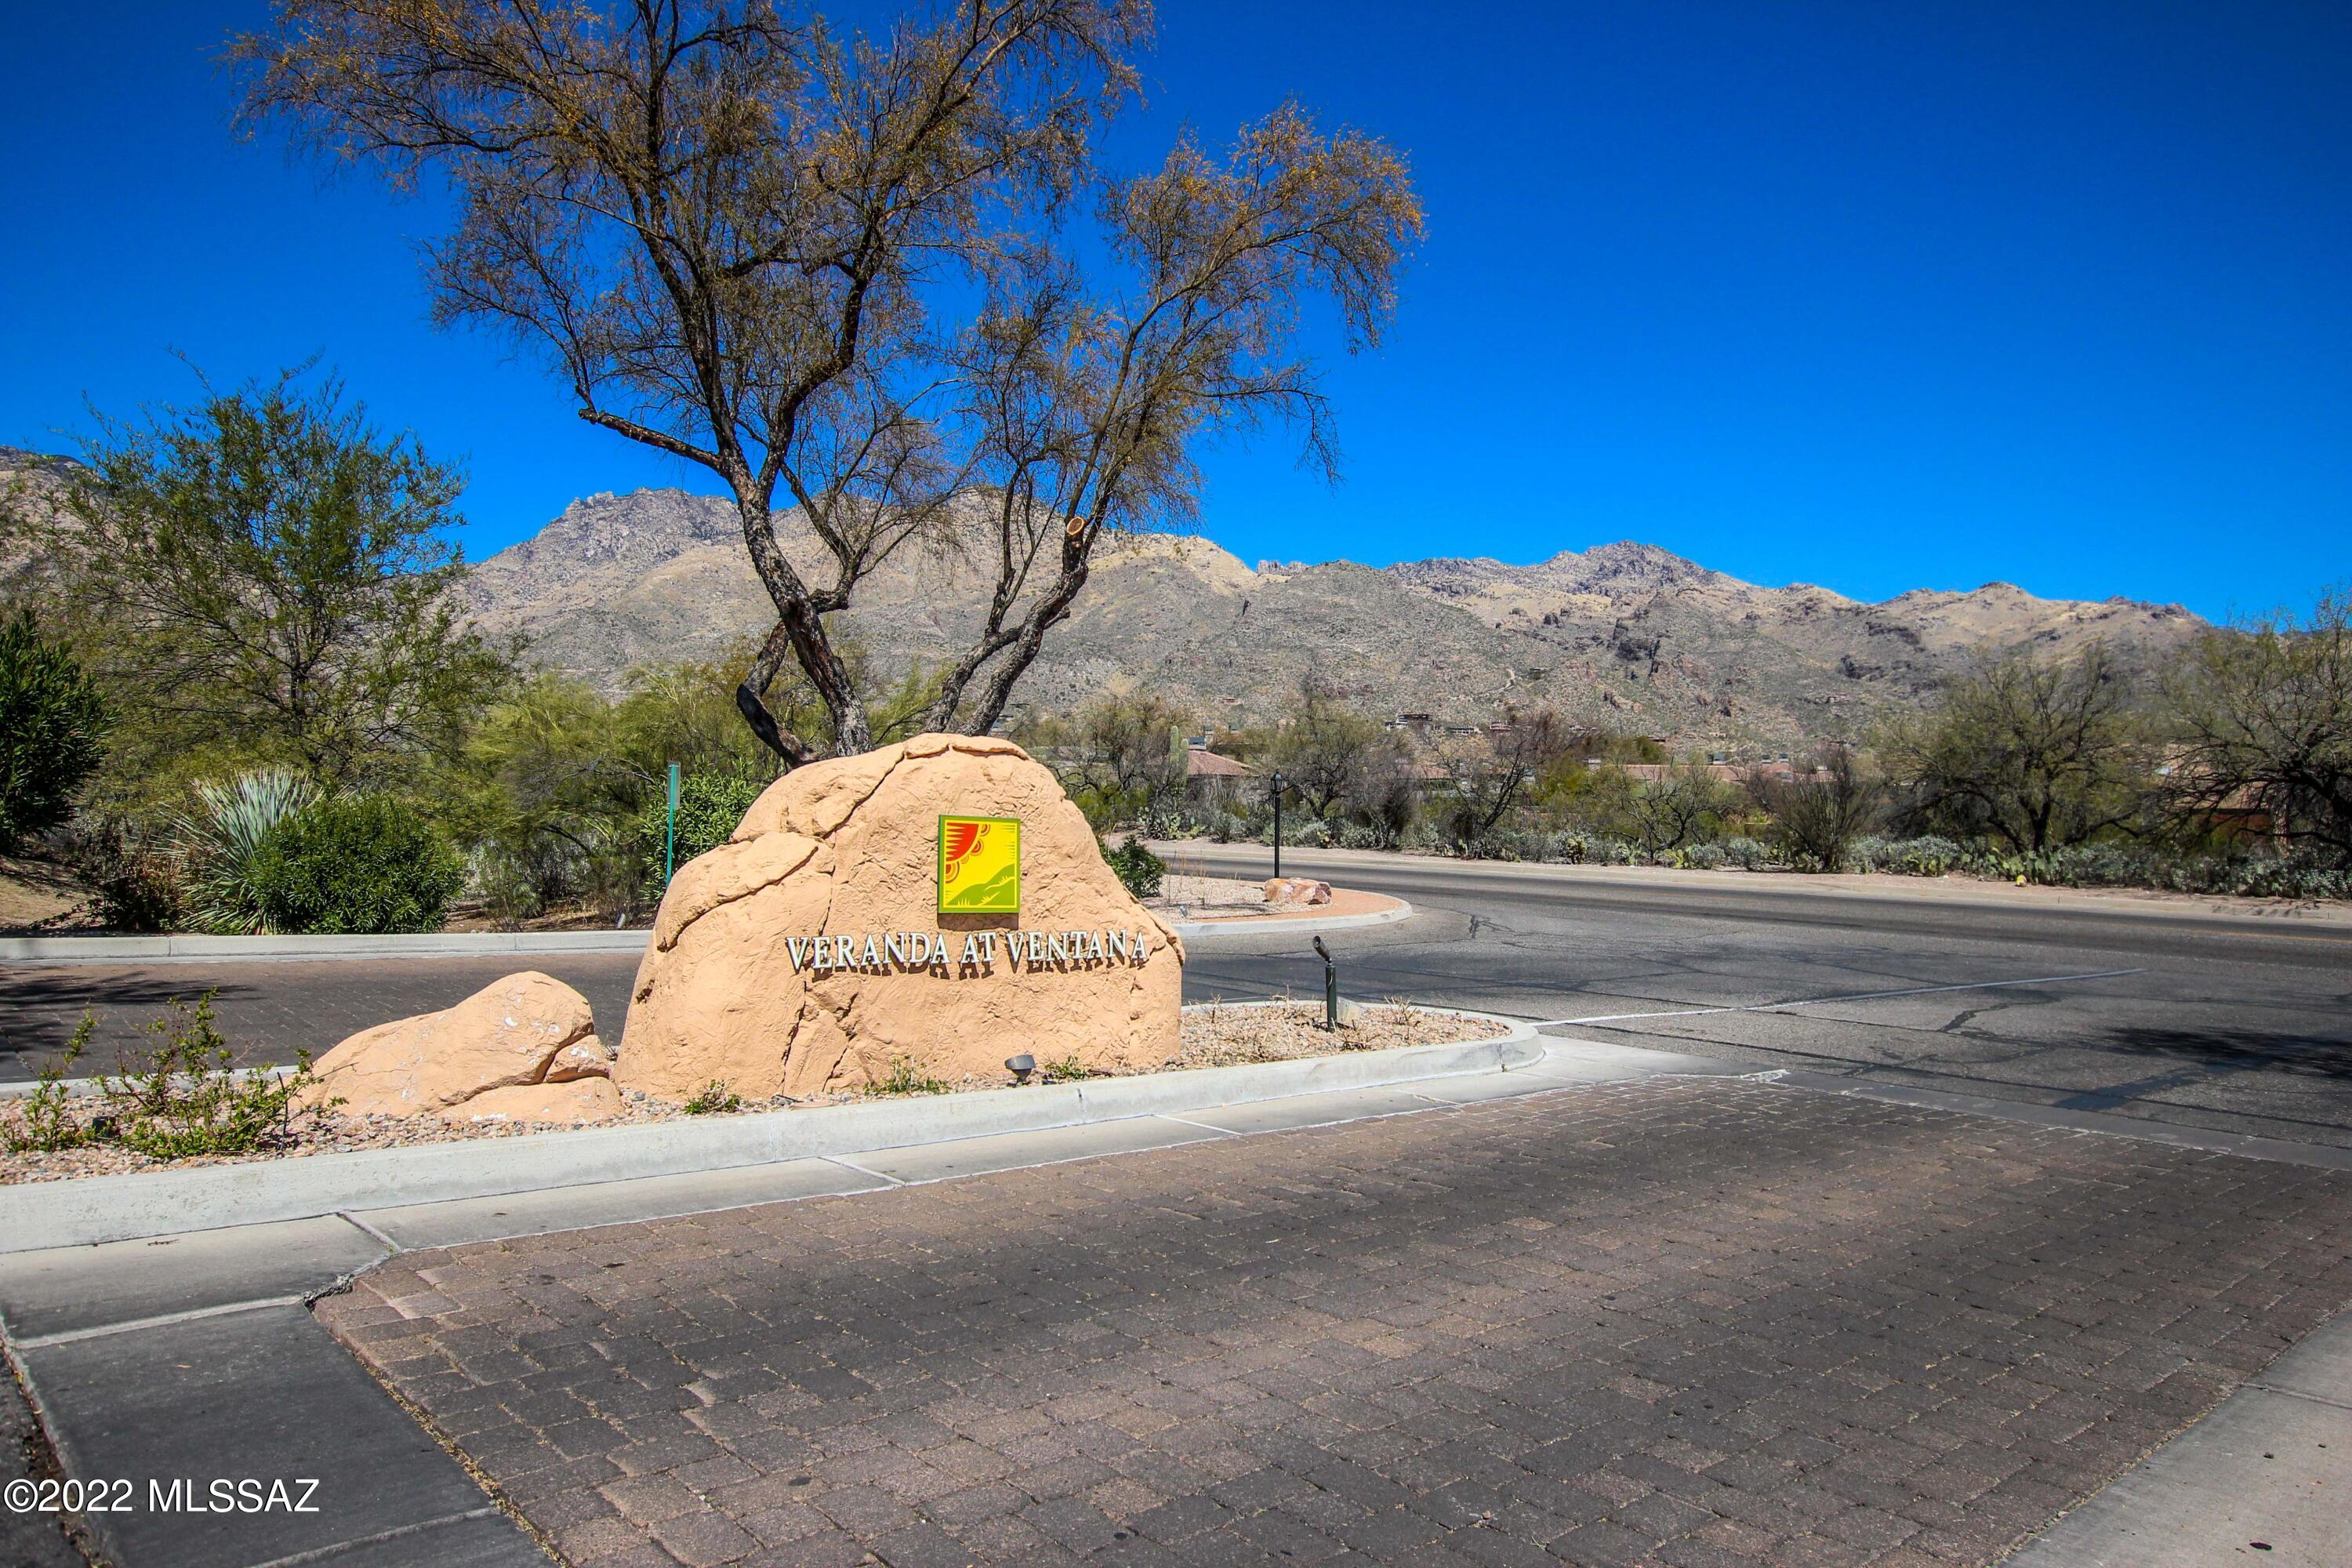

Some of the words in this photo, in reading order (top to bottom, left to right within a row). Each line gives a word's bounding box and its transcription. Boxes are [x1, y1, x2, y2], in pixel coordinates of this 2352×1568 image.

[786, 932, 950, 970] VERANDA
[960, 934, 997, 963] AT
[1007, 929, 1148, 964] VENTANA
